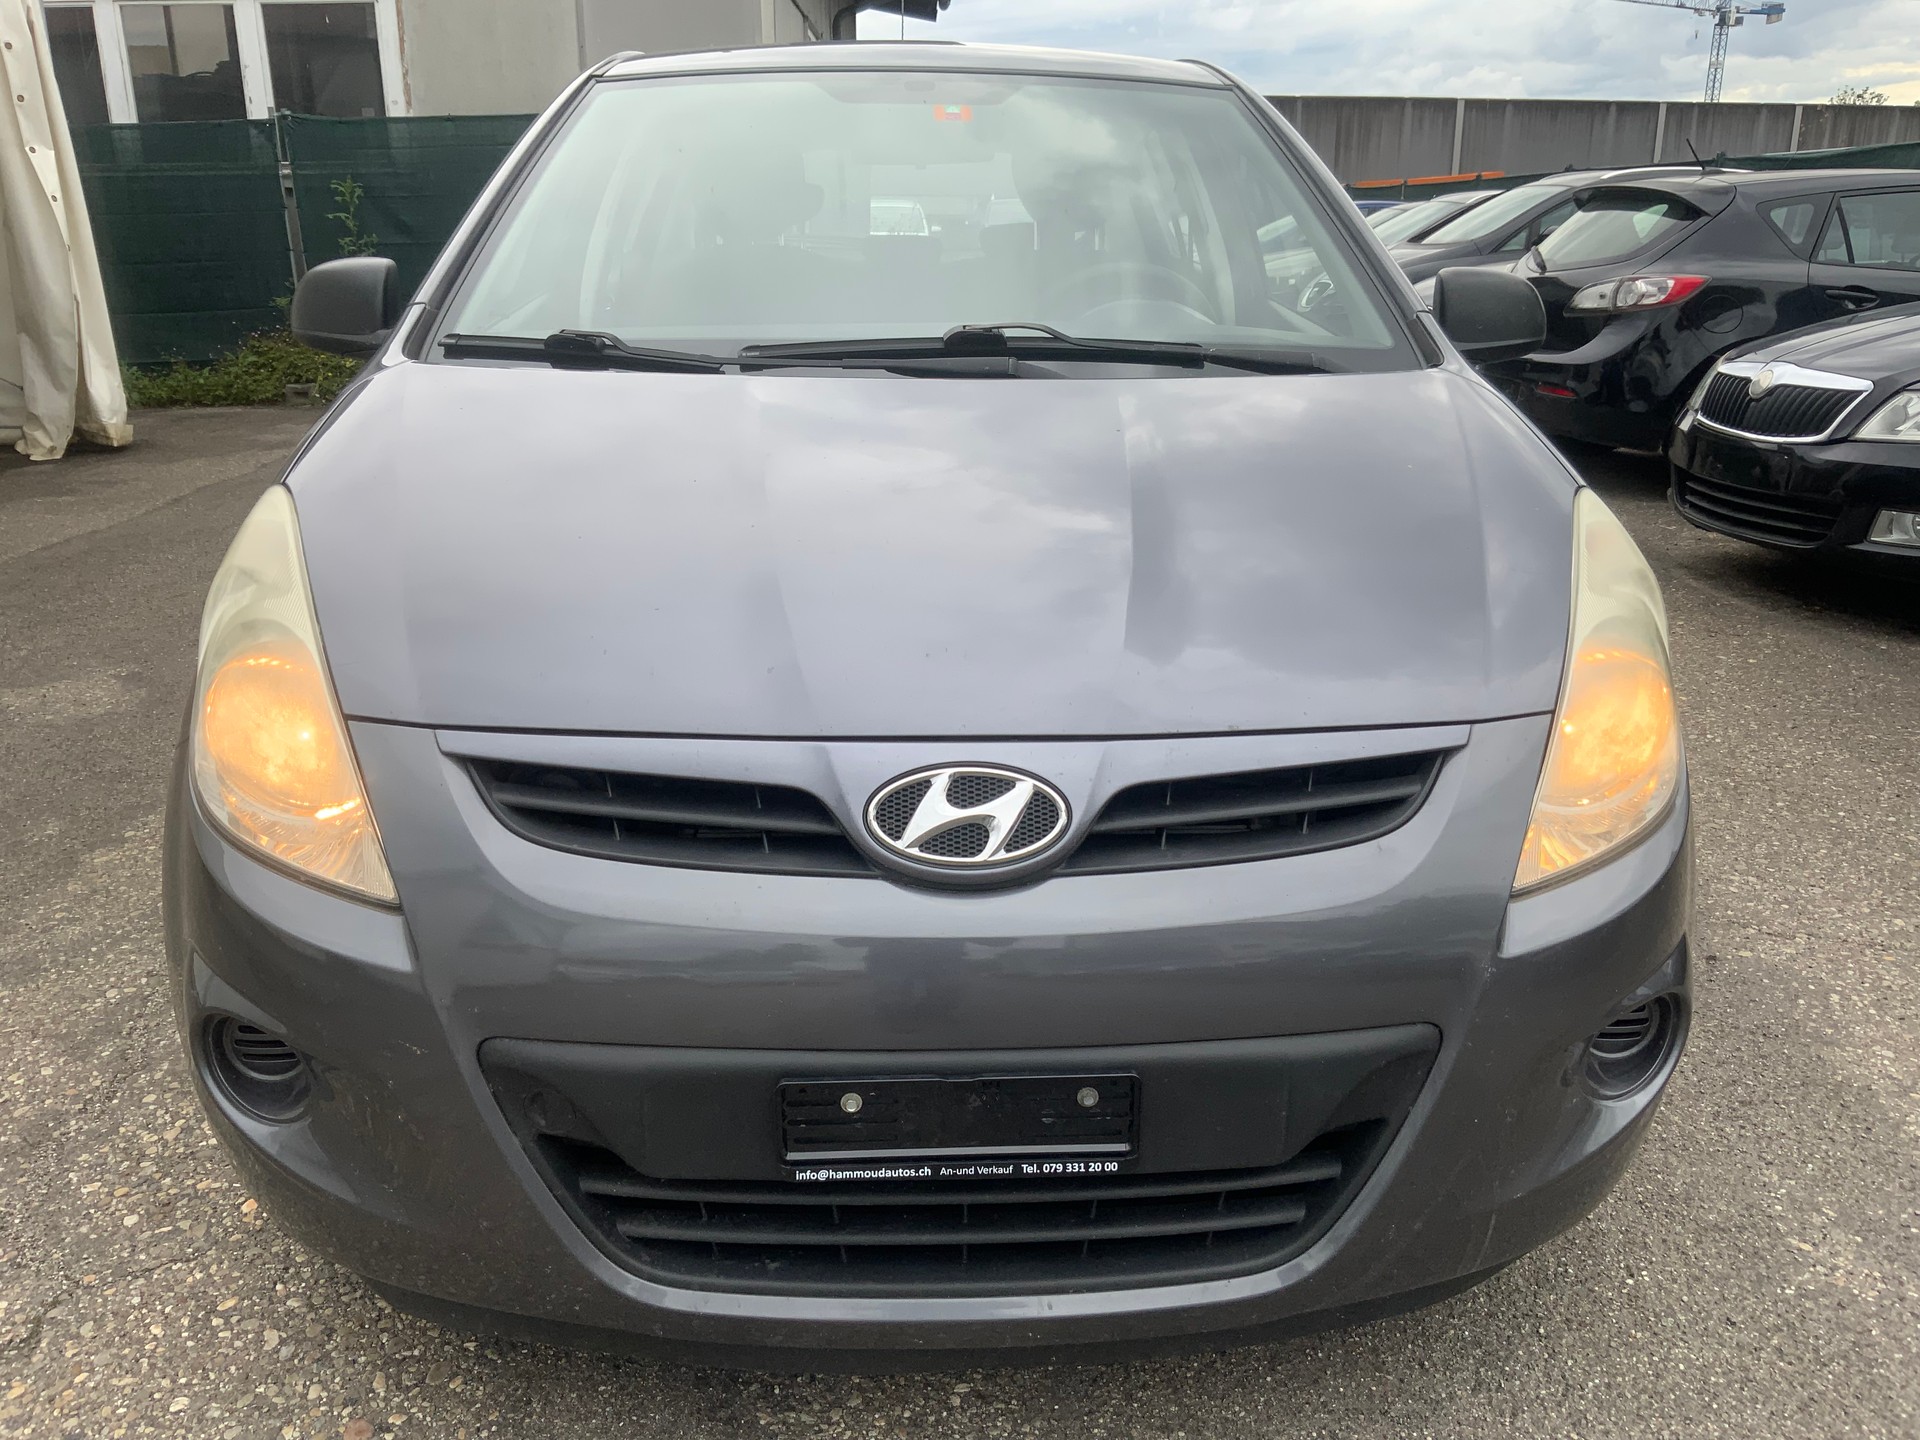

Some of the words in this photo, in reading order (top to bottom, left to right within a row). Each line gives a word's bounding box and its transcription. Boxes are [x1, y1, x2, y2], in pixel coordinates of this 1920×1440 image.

[795, 1166, 932, 1181] info@hammoudautos.ch
[940, 1165, 975, 1176] An-und
[976, 1164, 1014, 1175] Verkauf
[1021, 1164, 1040, 1174] Tel.
[1042, 1163, 1063, 1173] 079
[1065, 1162, 1086, 1173] 331
[1088, 1162, 1102, 1172] 20
[1104, 1161, 1118, 1172] 00
